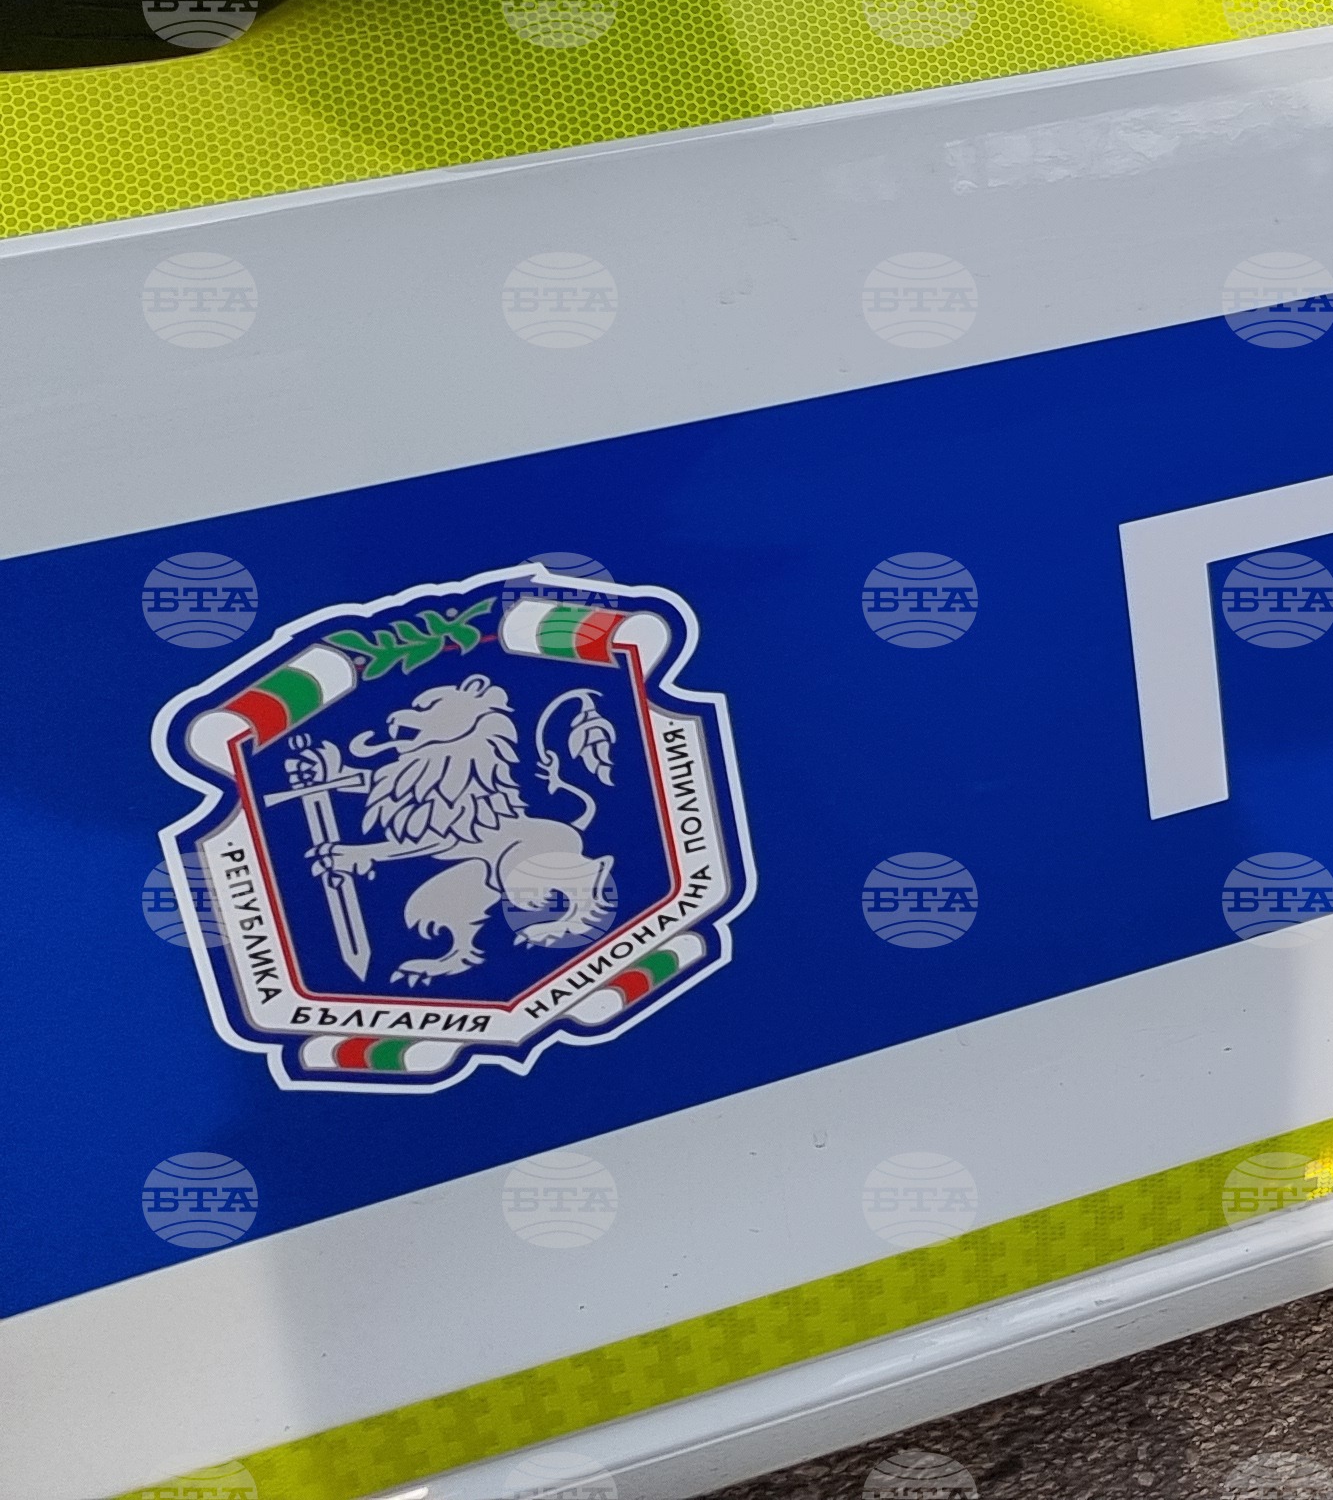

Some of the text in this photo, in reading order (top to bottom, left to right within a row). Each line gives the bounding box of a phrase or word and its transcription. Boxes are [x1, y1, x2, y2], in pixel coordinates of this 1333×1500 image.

[224, 847, 491, 1034] РЕПУБЛИКА БЪЛГАРИЯ
[524, 726, 713, 1021] НАЦИОНАЛНА ПОЛИЦИЯ
